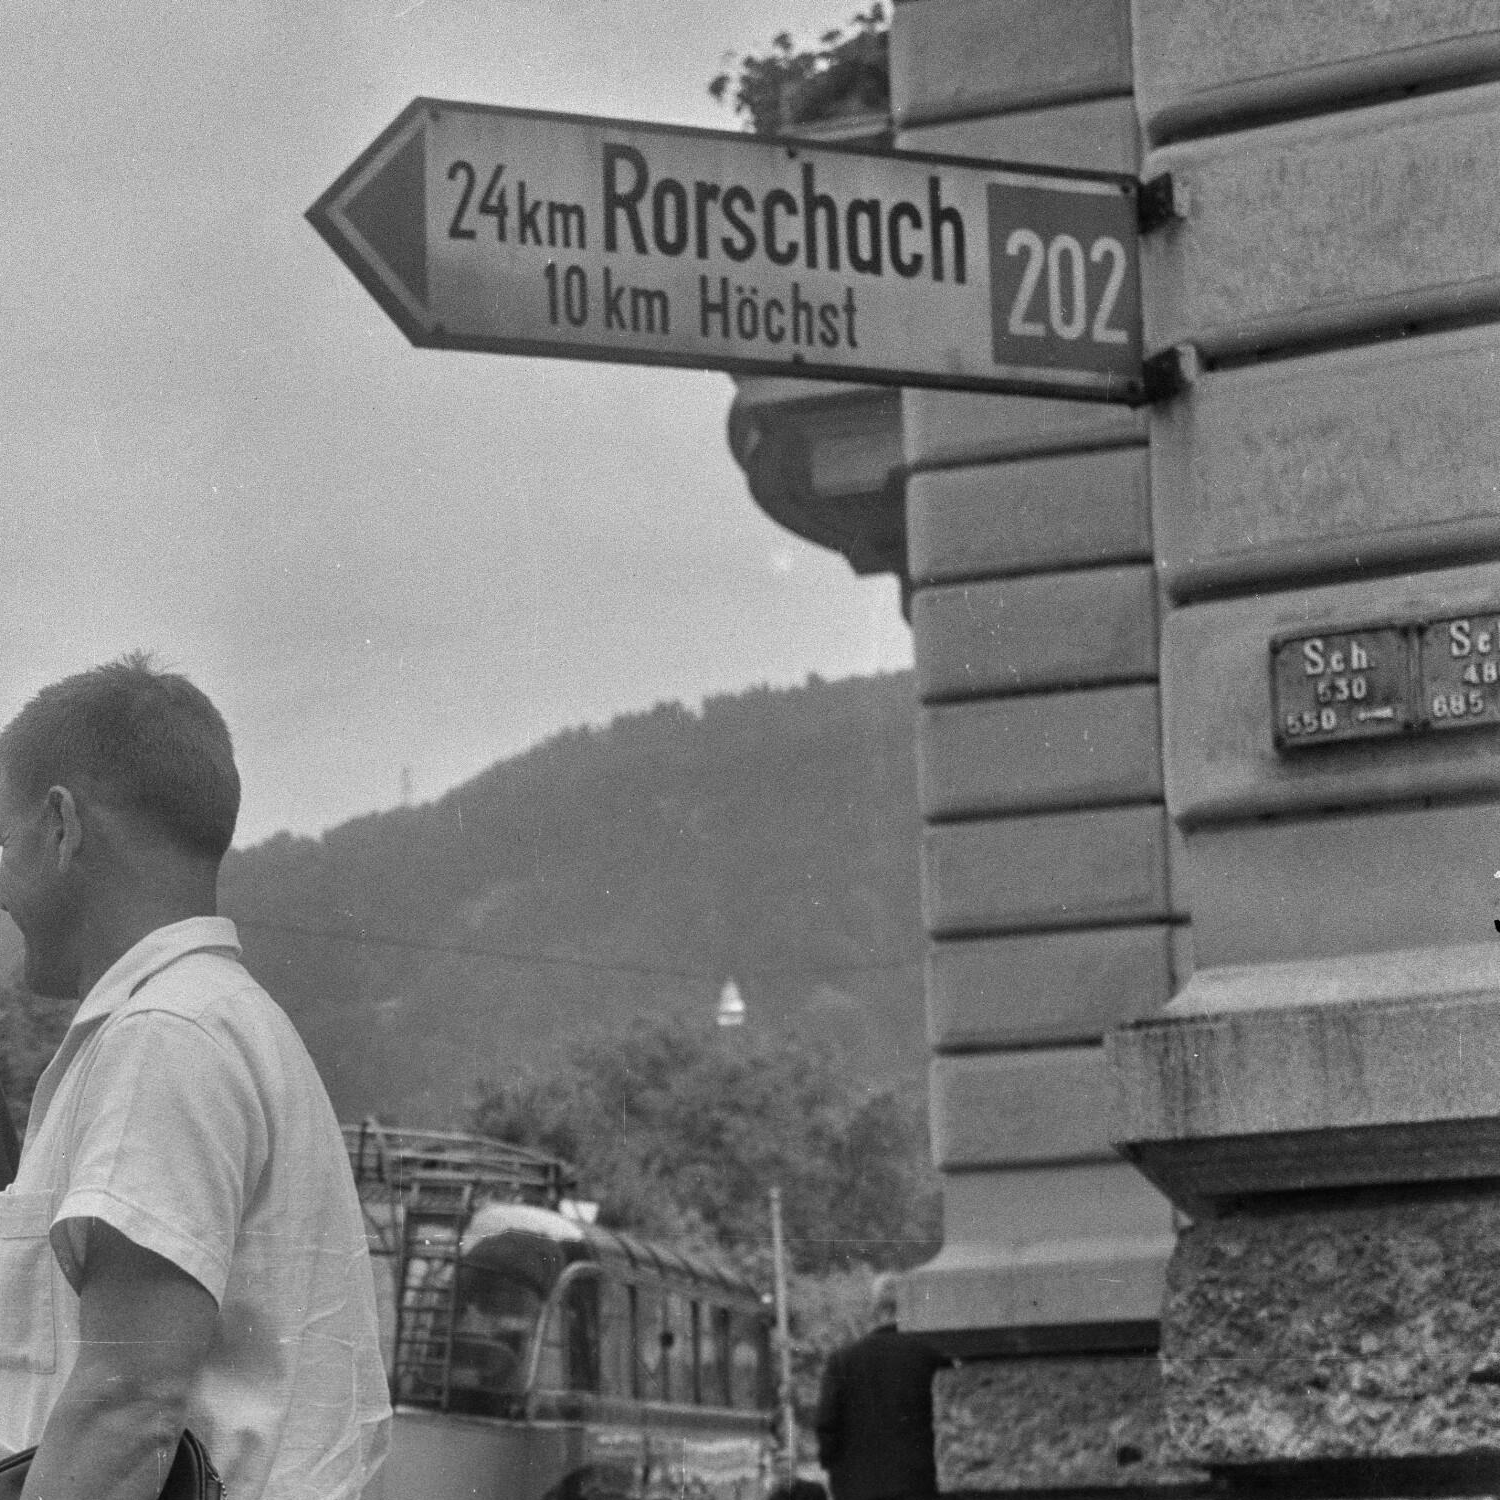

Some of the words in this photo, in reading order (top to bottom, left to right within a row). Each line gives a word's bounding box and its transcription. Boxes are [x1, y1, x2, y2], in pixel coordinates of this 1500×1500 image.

[603, 141, 966, 285] Rorschach
[545, 262, 588, 327] 10
[604, 266, 668, 334] km
[700, 274, 858, 349] Höchst
[1006, 228, 1129, 344] 202
